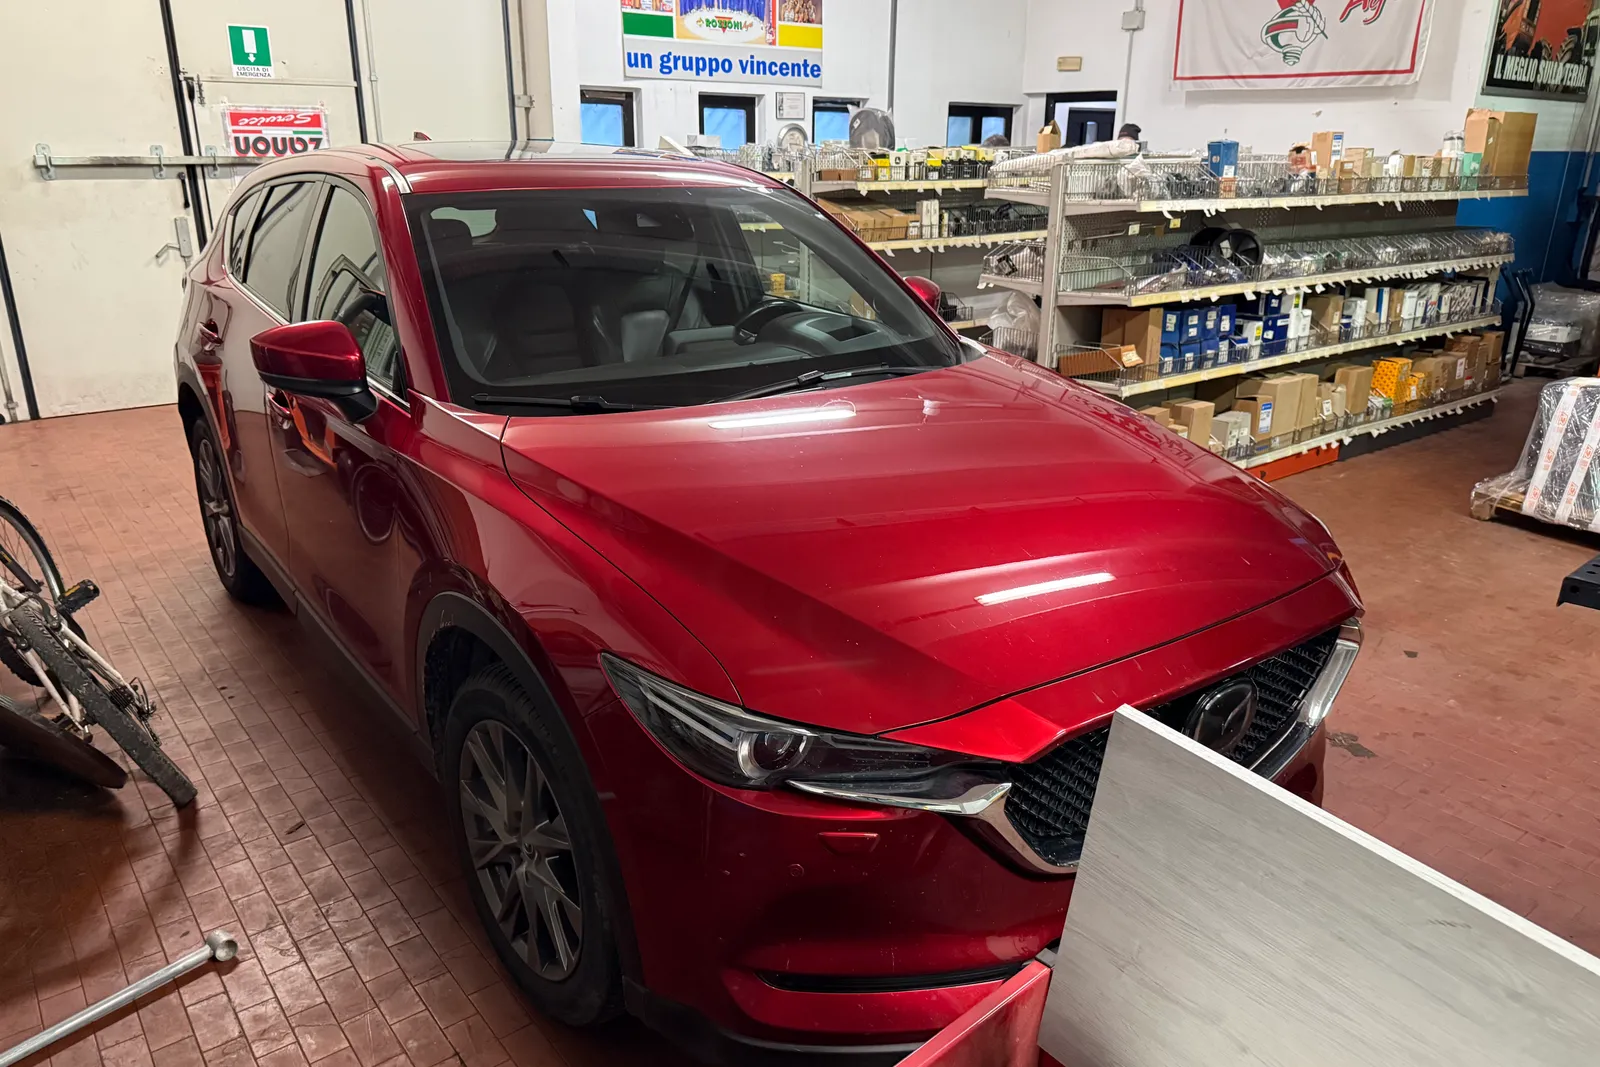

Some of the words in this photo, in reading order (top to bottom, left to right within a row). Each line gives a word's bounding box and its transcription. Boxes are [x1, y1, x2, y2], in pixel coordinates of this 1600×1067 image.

[626, 51, 653, 69] un
[659, 51, 733, 77] gruppo
[739, 54, 821, 78] vincente
[1493, 54, 1504, 79] IL
[1502, 55, 1538, 83] MEGLIO
[1537, 59, 1564, 85] SULLA
[1562, 63, 1588, 88] TERRA
[238, 112, 314, 126] Service
